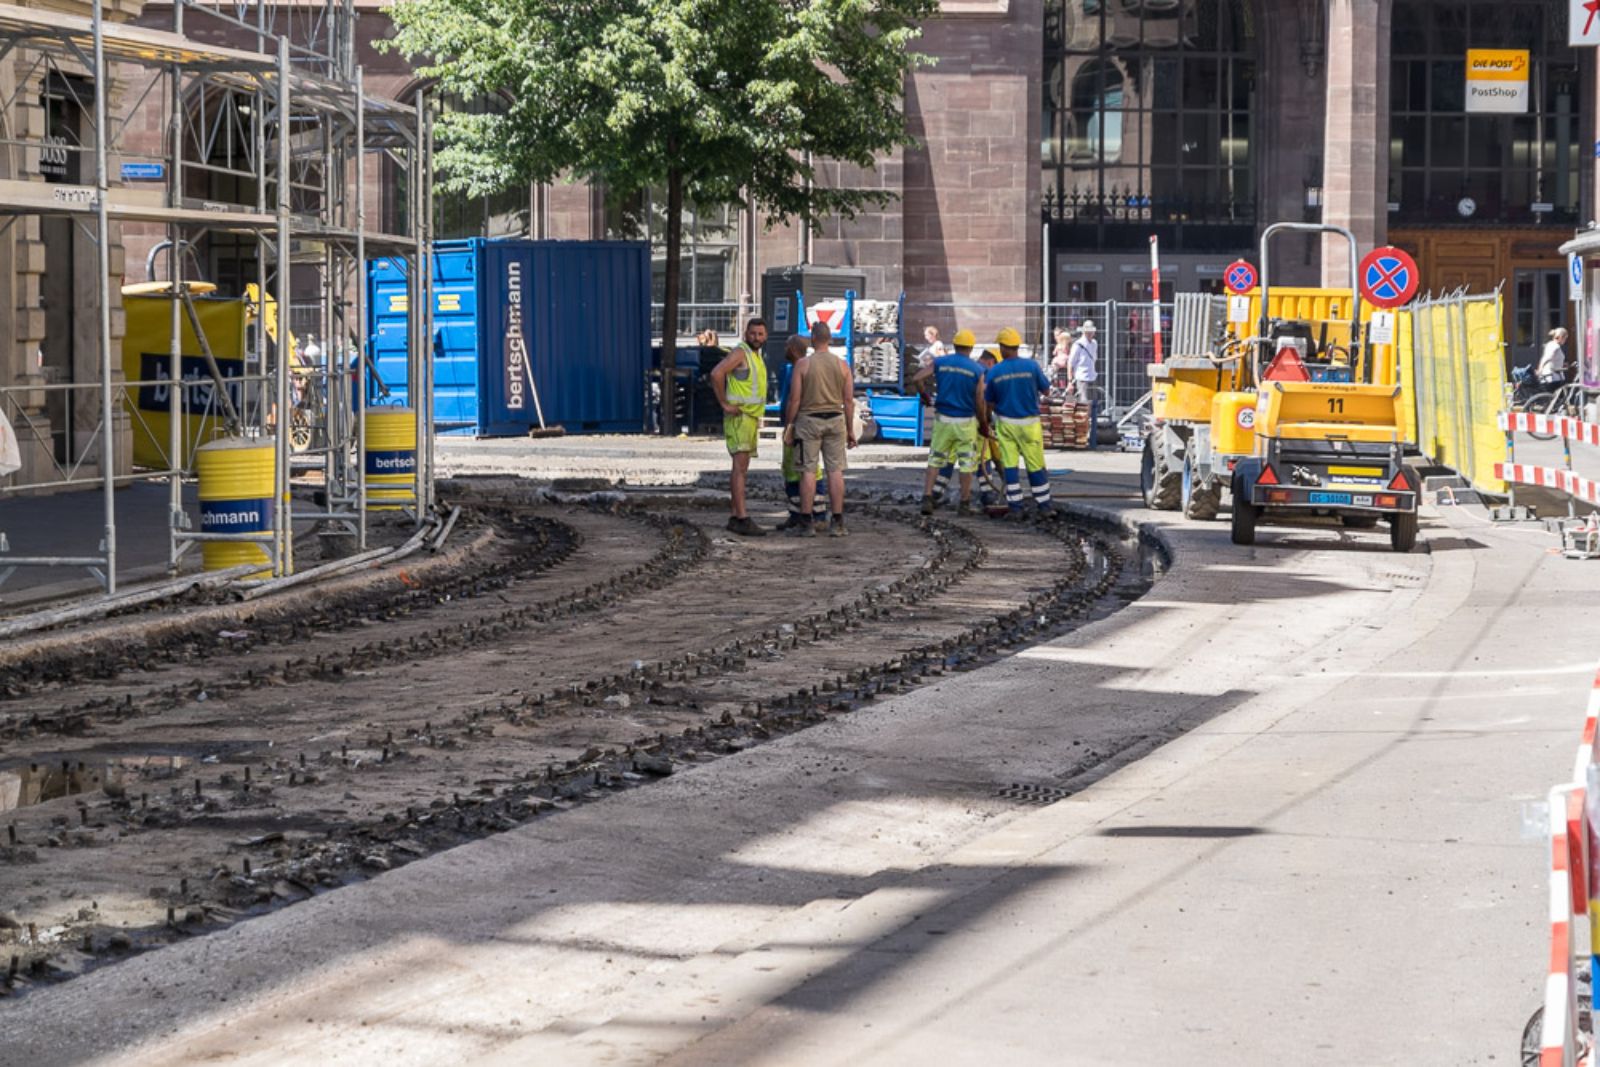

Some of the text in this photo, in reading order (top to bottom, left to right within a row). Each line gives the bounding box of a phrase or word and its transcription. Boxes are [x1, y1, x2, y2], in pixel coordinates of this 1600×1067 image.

[1472, 59, 1513, 69] DIE POST
[1471, 87, 1518, 98] PostShop
[506, 261, 523, 409] bertschmann
[153, 361, 242, 408] brtsh
[1328, 398, 1344, 414] 11
[1241, 411, 1254, 423] 25
[201, 510, 260, 525] chmann
